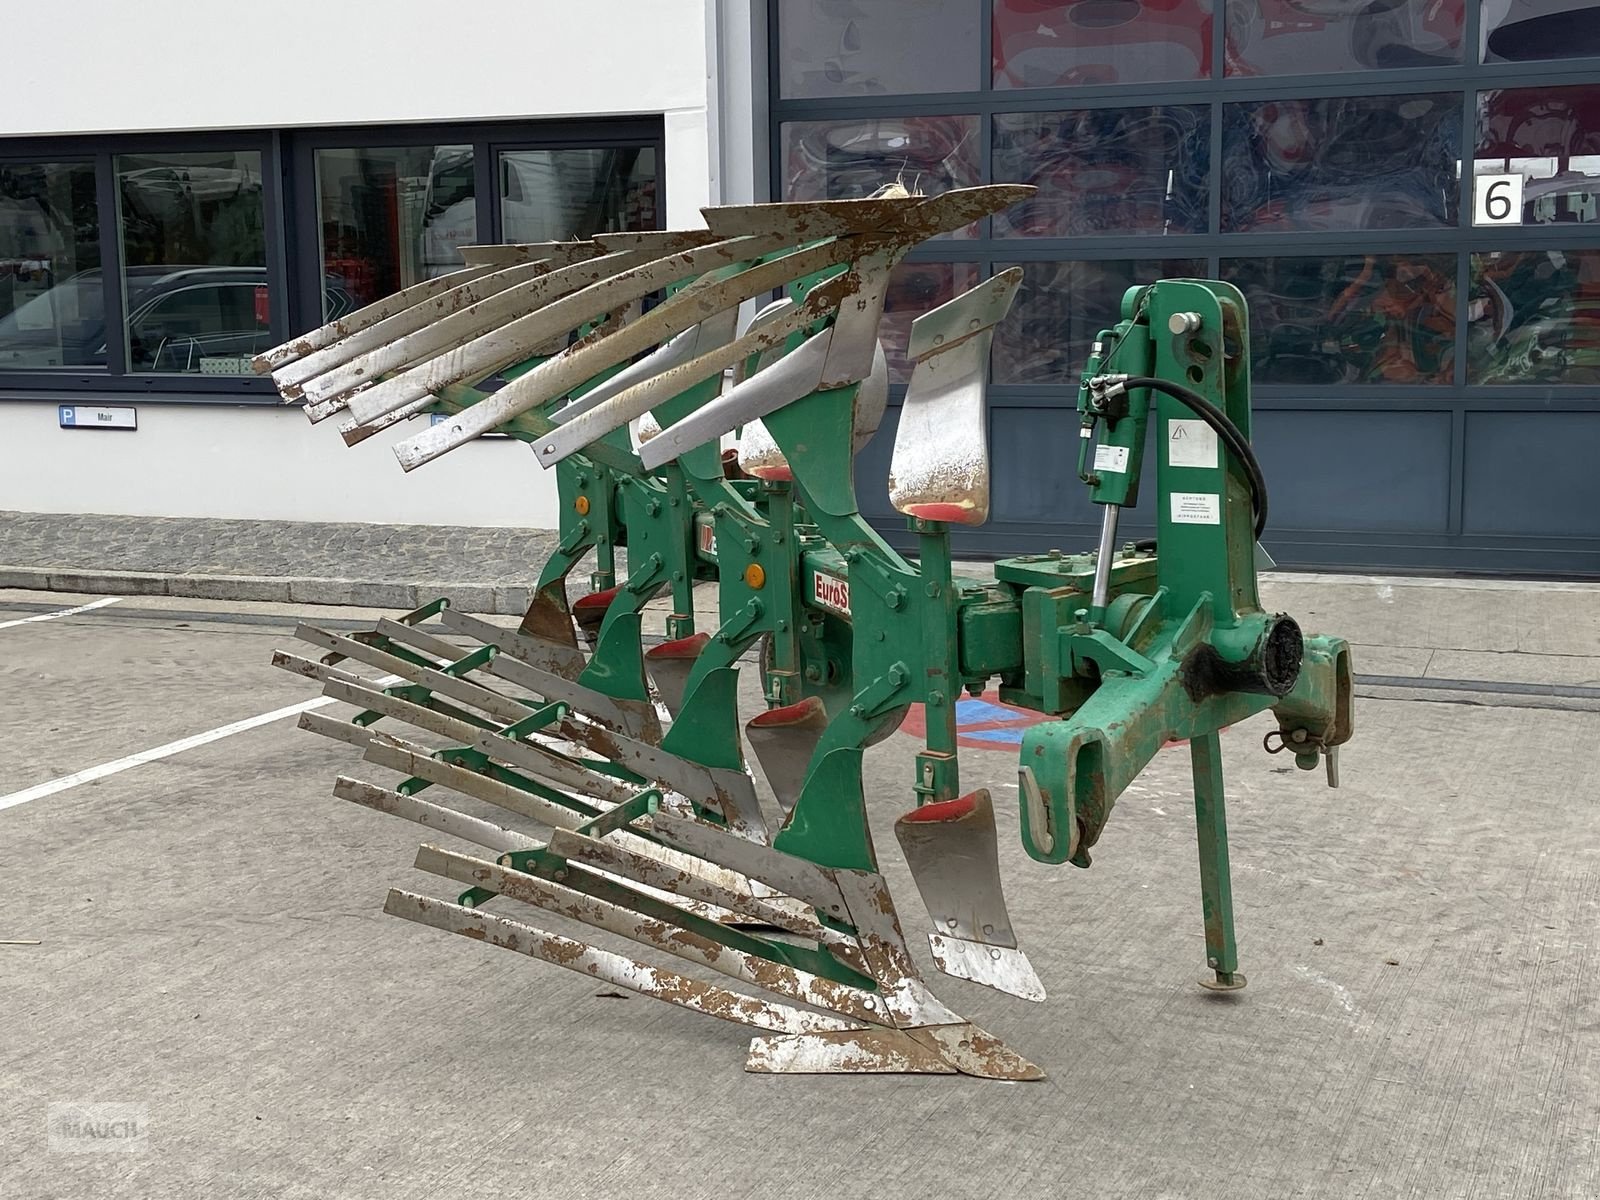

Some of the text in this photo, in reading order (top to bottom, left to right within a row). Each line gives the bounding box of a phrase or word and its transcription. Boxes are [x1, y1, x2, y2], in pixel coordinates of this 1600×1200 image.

[1485, 181, 1511, 220] 6
[63, 409, 113, 423] P Mair
